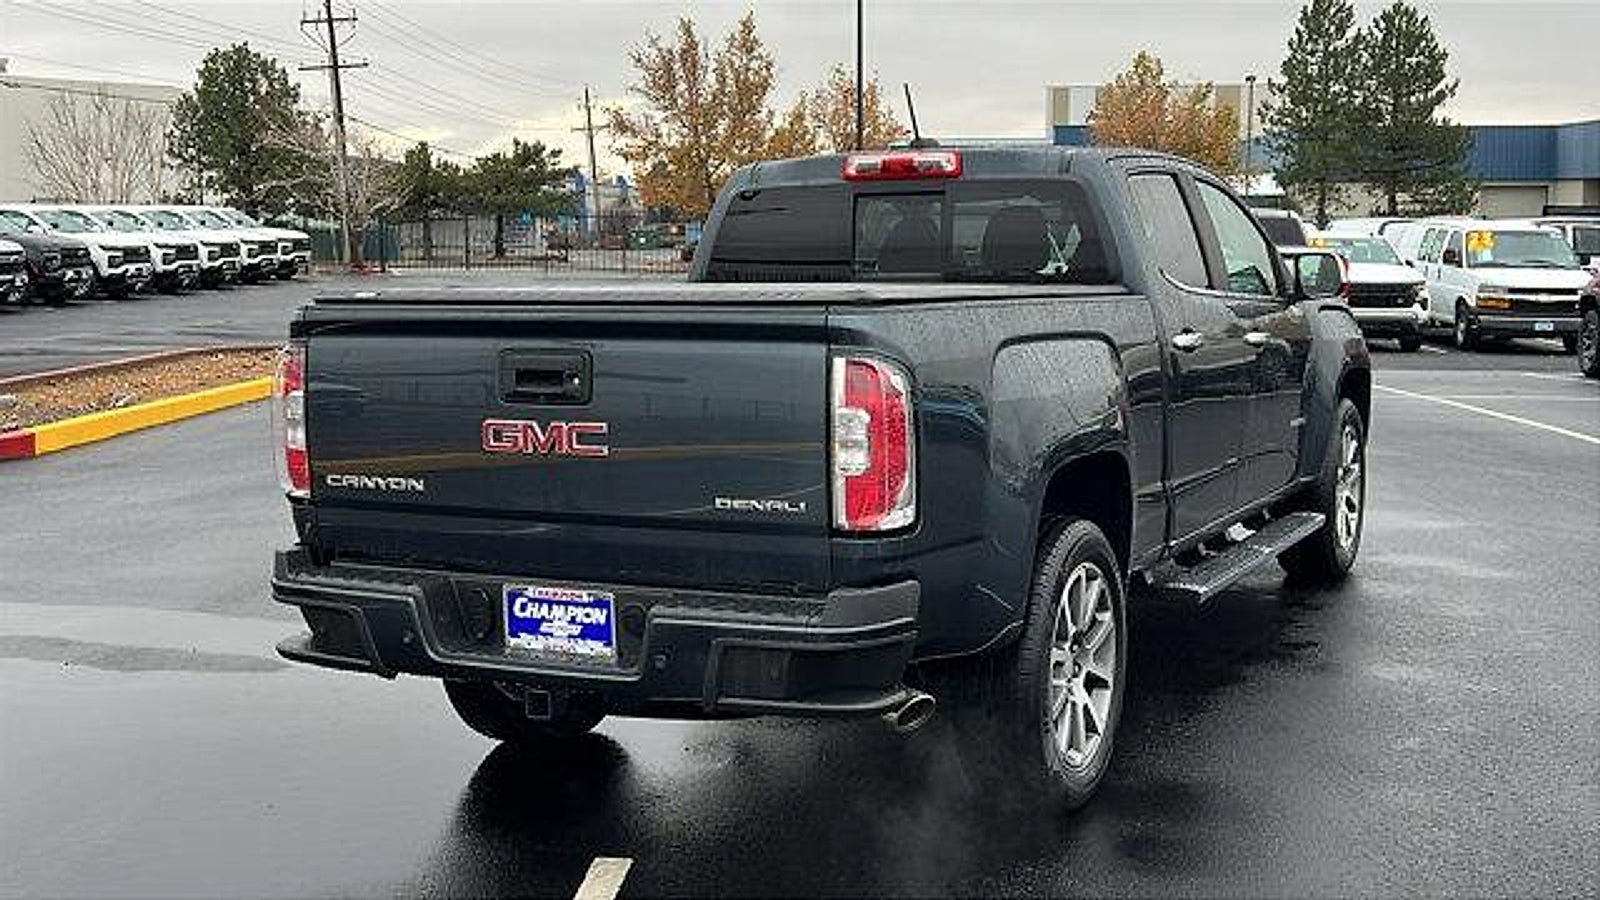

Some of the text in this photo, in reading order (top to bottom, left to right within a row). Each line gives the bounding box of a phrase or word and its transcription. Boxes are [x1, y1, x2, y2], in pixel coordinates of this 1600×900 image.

[481, 419, 609, 457] GMC
[325, 474, 425, 492] CANYON
[714, 497, 808, 512] DENALI
[512, 596, 608, 625] CHAMPION
